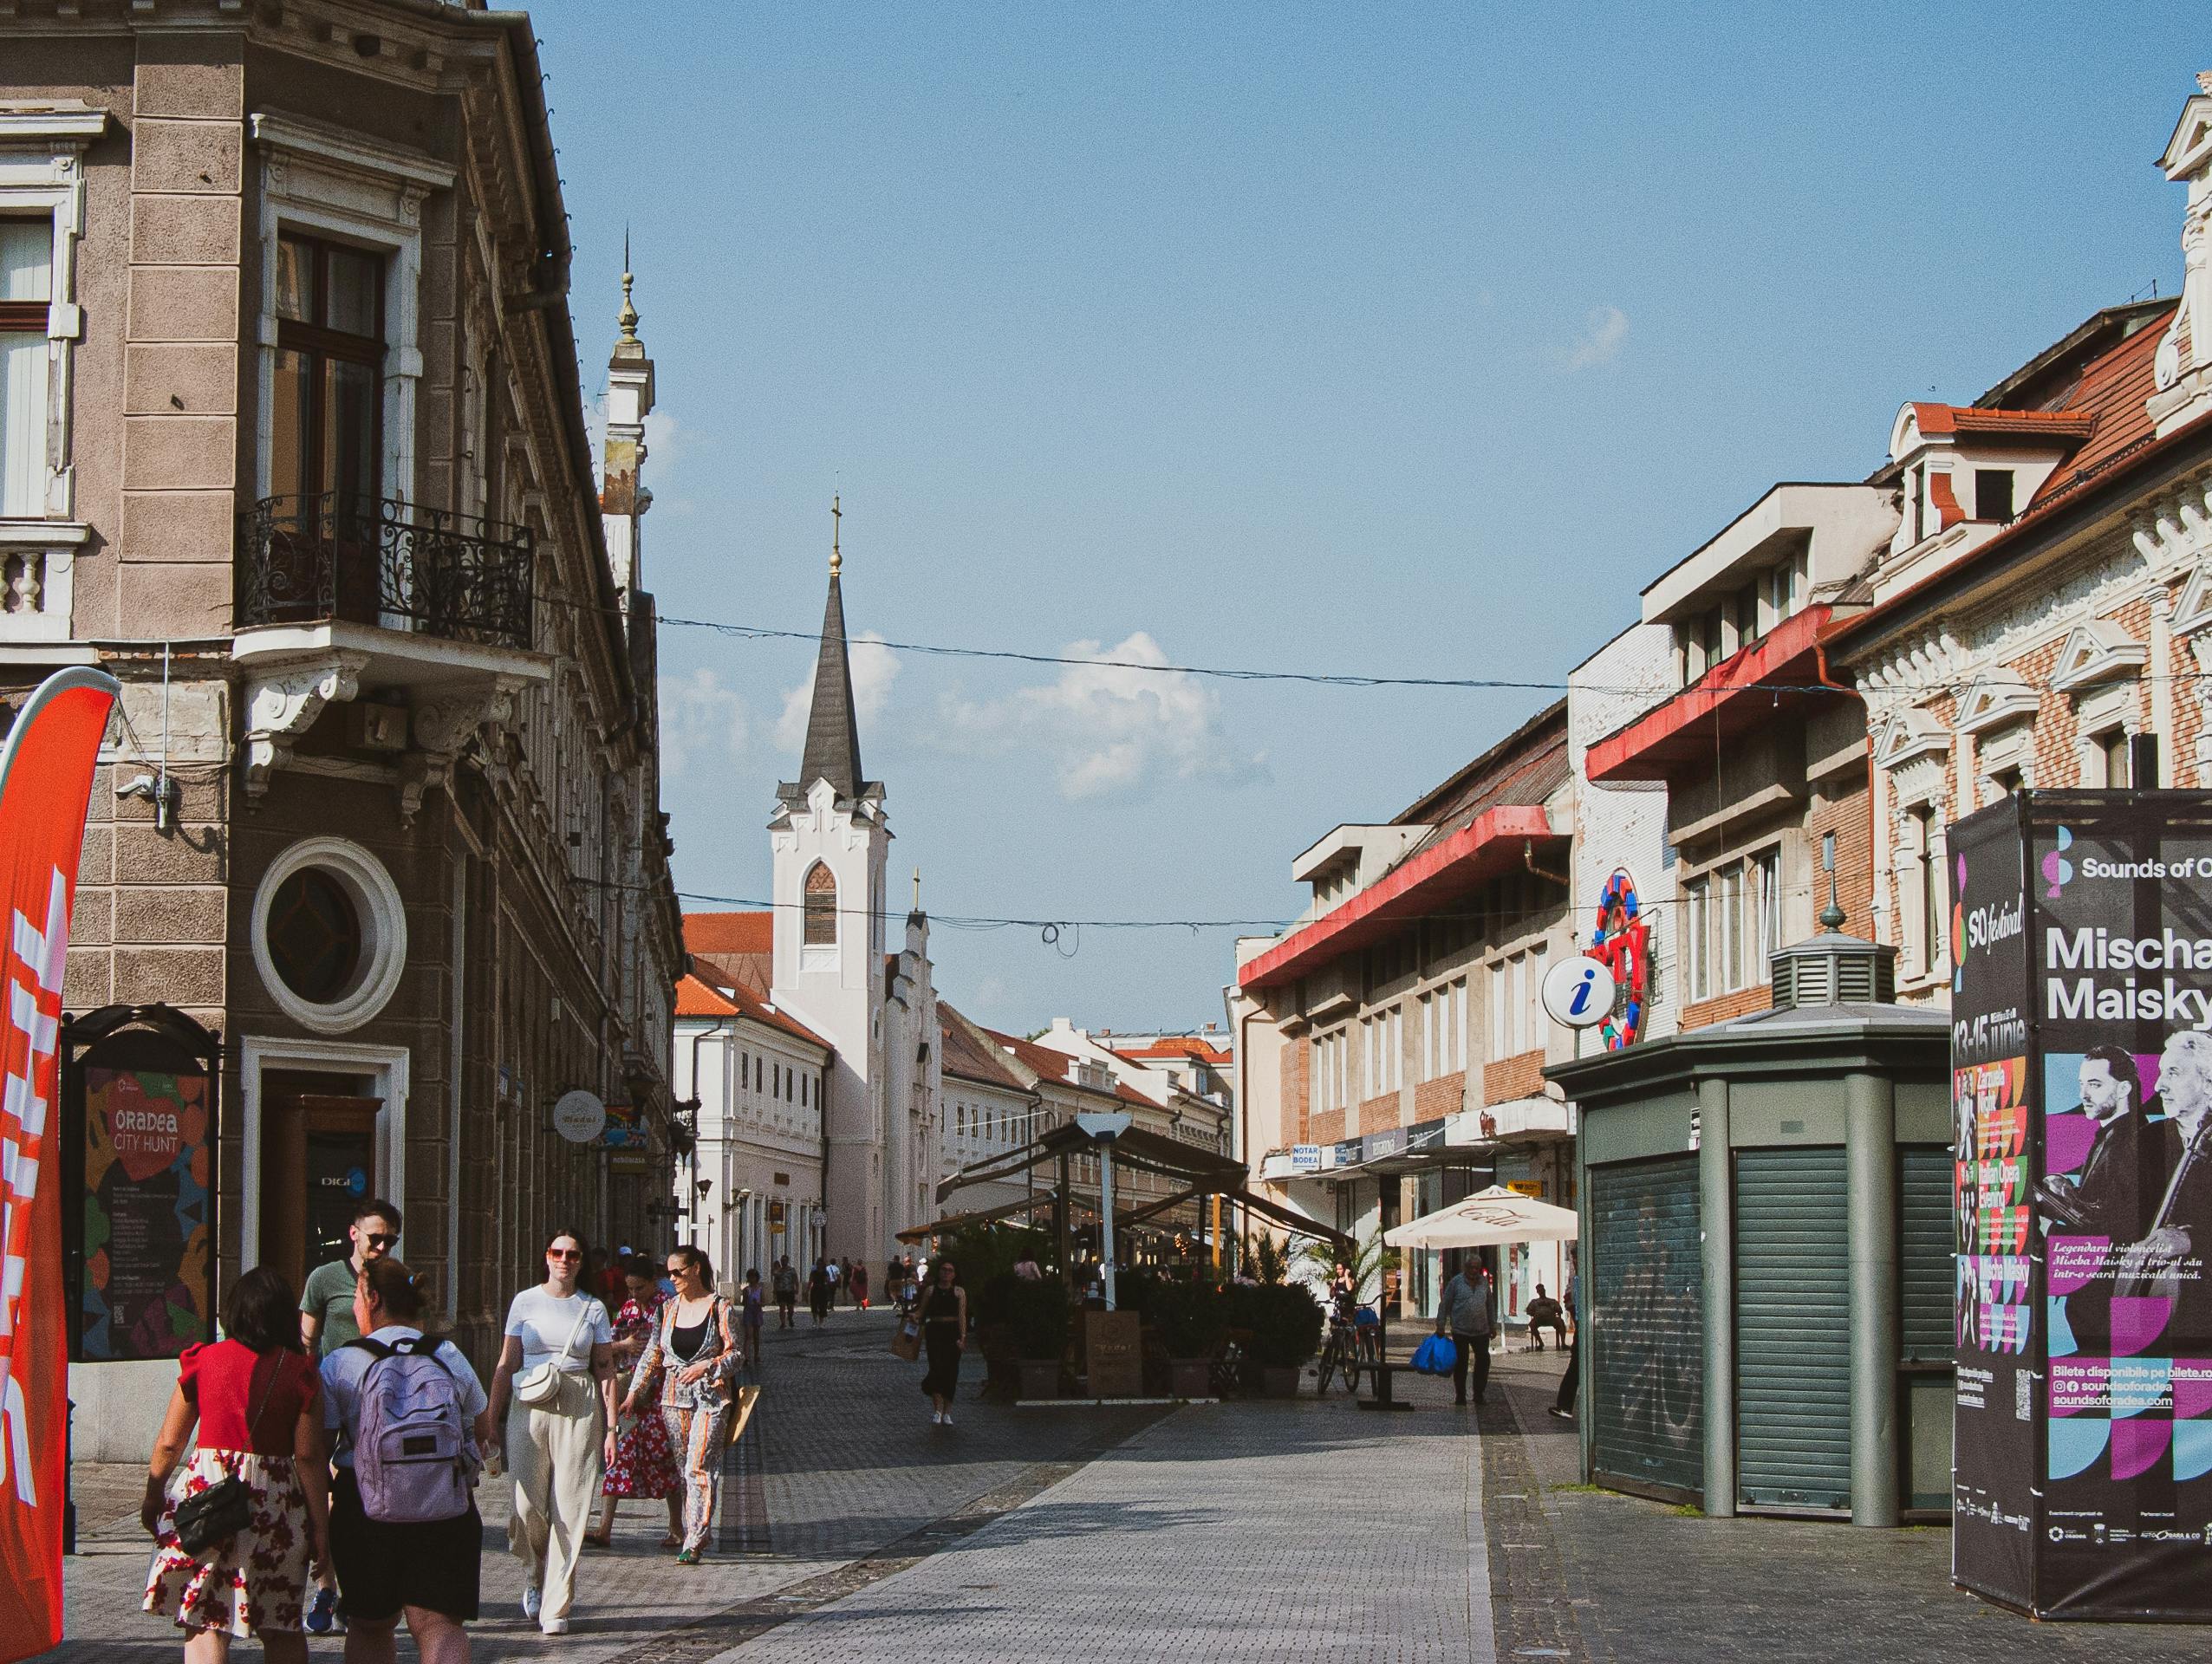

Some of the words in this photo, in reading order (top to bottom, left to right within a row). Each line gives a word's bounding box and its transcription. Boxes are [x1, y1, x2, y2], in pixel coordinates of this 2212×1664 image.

[2082, 858, 2166, 878] Sounds
[2170, 857, 2195, 878] of
[2046, 927, 2212, 970] Mischa
[2047, 977, 2212, 1031] Maisky
[114, 1131, 140, 1150] CITY
[144, 1135, 178, 1153] HUNT
[2053, 1242, 2114, 1255] Legendarul
[2053, 1255, 2091, 1266] Mischa
[2092, 1256, 2133, 1268] Maisky
[2148, 1257, 2182, 1266] trio-ul
[2053, 1269, 2085, 1278] într-o
[2053, 1366, 2085, 1377] Bilete
[2086, 1366, 2150, 1379] disponibile
[2150, 1368, 2165, 1379] pe
[2168, 1367, 2212, 1378] bilete.ro
[2081, 1381, 2173, 1392] soundsoforadea
[2053, 1394, 2173, 1406] soundsoforadea.com
